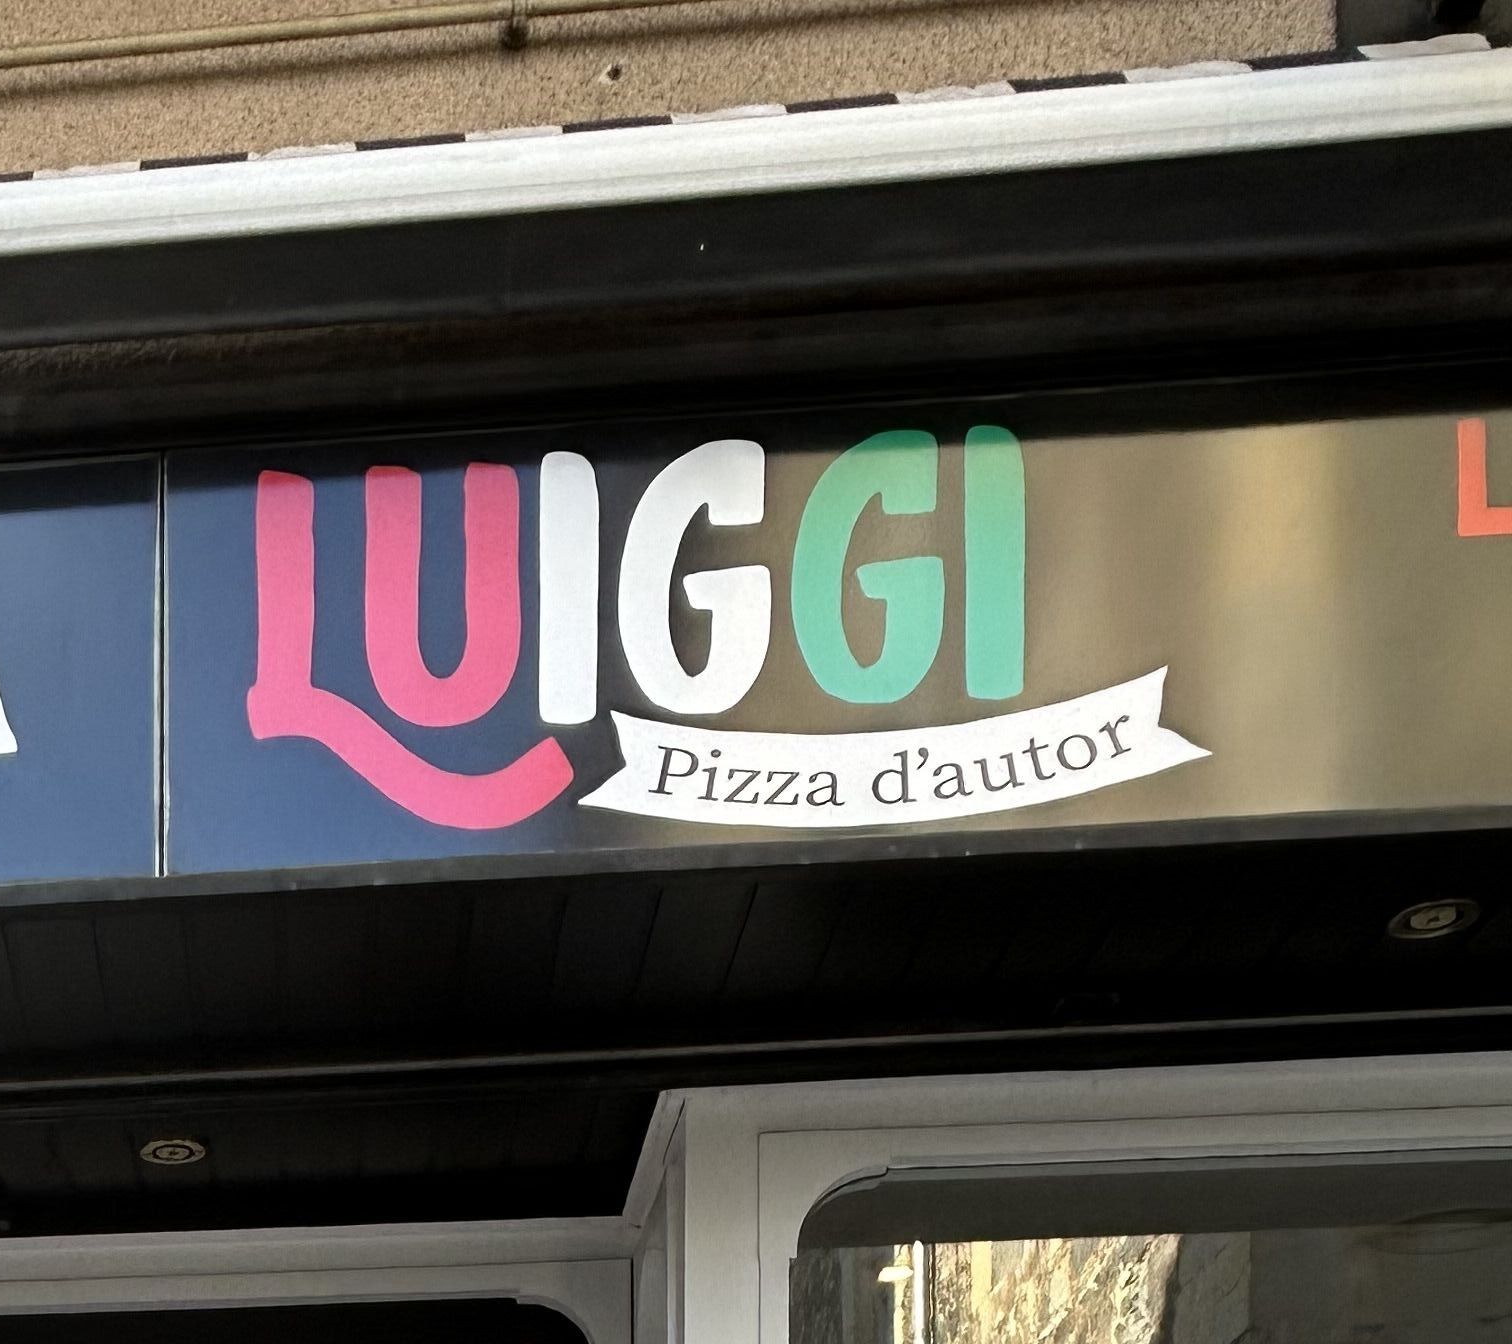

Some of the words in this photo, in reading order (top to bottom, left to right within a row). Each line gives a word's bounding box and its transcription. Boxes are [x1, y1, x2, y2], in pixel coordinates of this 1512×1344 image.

[246, 425, 1026, 830] LUIGGI
[647, 744, 845, 808] Pizza
[870, 712, 1133, 806] d'autor
